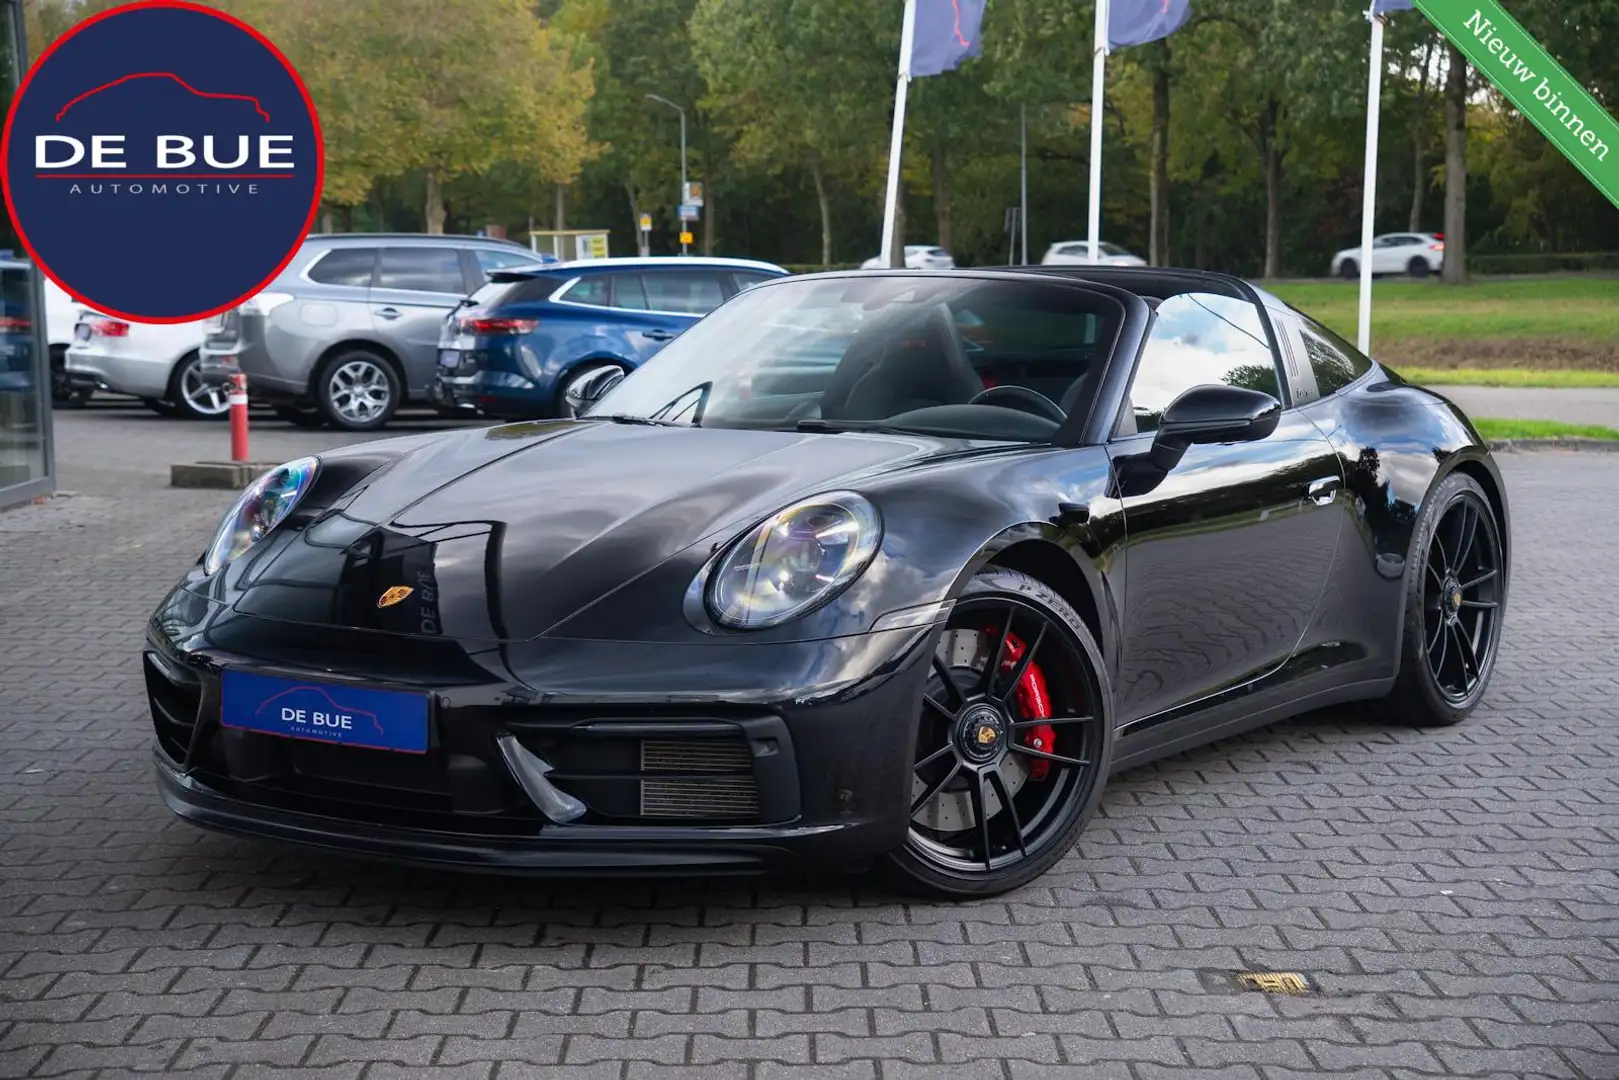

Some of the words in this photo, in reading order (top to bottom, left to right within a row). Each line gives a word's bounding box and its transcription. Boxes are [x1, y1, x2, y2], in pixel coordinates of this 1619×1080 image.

[281, 707, 307, 724] DE
[312, 711, 353, 730] BUE
[290, 726, 342, 737] AUTOMOTIVE
